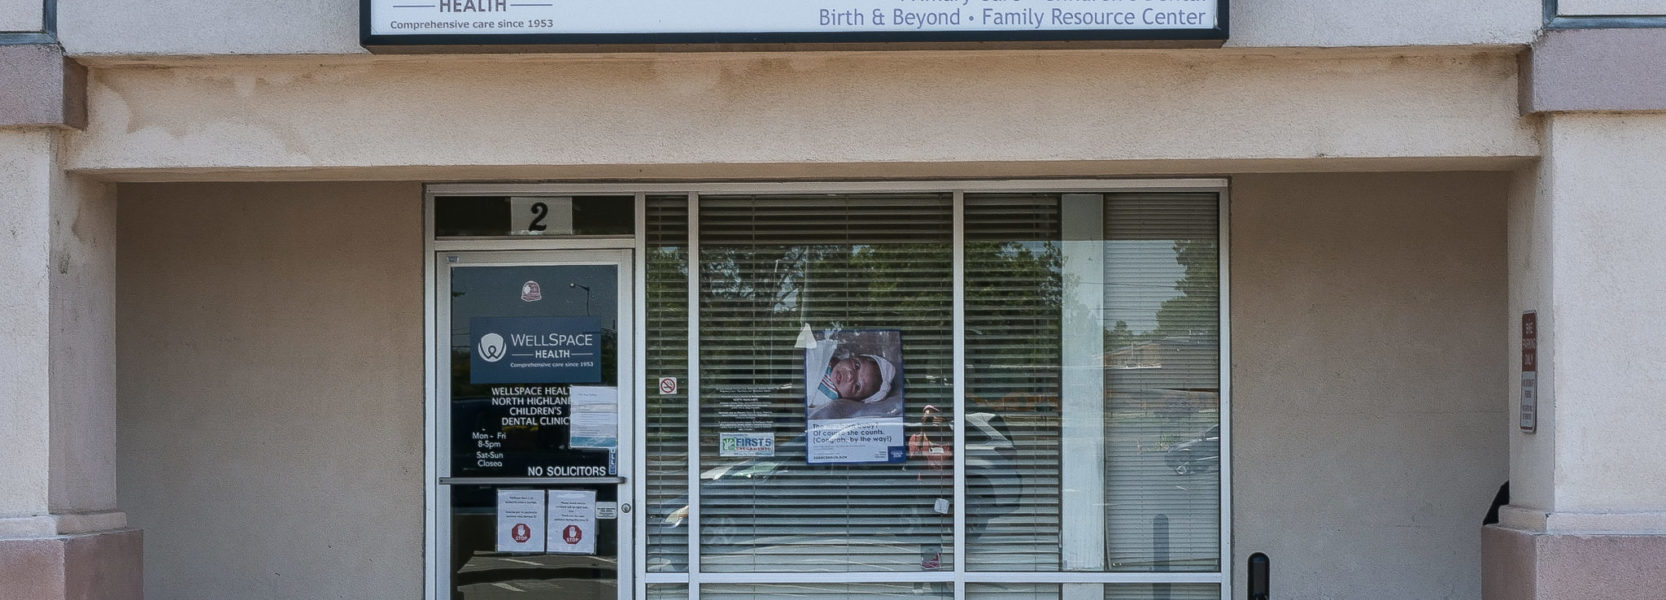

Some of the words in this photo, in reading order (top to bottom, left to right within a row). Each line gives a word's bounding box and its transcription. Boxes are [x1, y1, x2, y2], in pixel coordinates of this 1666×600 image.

[819, 8, 864, 26] Birth
[872, 8, 886, 26] &
[893, 8, 960, 30] Beyond
[982, 8, 1045, 29] Family
[1051, 8, 1136, 25] Resource
[1142, 8, 1206, 25] Center
[390, 20, 470, 31] Comprehensive
[472, 21, 495, 29] care
[497, 19, 524, 28] since
[527, 19, 554, 28] 1953
[528, 202, 548, 232] 2
[510, 333, 593, 347] WELLSPACE
[535, 349, 570, 359] HEALTH
[491, 386, 542, 396] WELLSPACE
[544, 386, 571, 396] HEALT
[491, 397, 525, 406] NORTH
[526, 396, 571, 405] HIGHLAN
[509, 406, 562, 416] CHILDREN'S
[501, 417, 538, 426] DENTAL
[539, 416, 570, 426] CLINIC
[472, 432, 489, 440] Mon
[497, 431, 507, 440] Fri
[477, 440, 501, 449] 8-5pm
[736, 438, 765, 447] FIRST
[476, 451, 504, 459] Sat-Sun
[527, 466, 543, 477] NO
[546, 466, 607, 477] SOLICITORS
